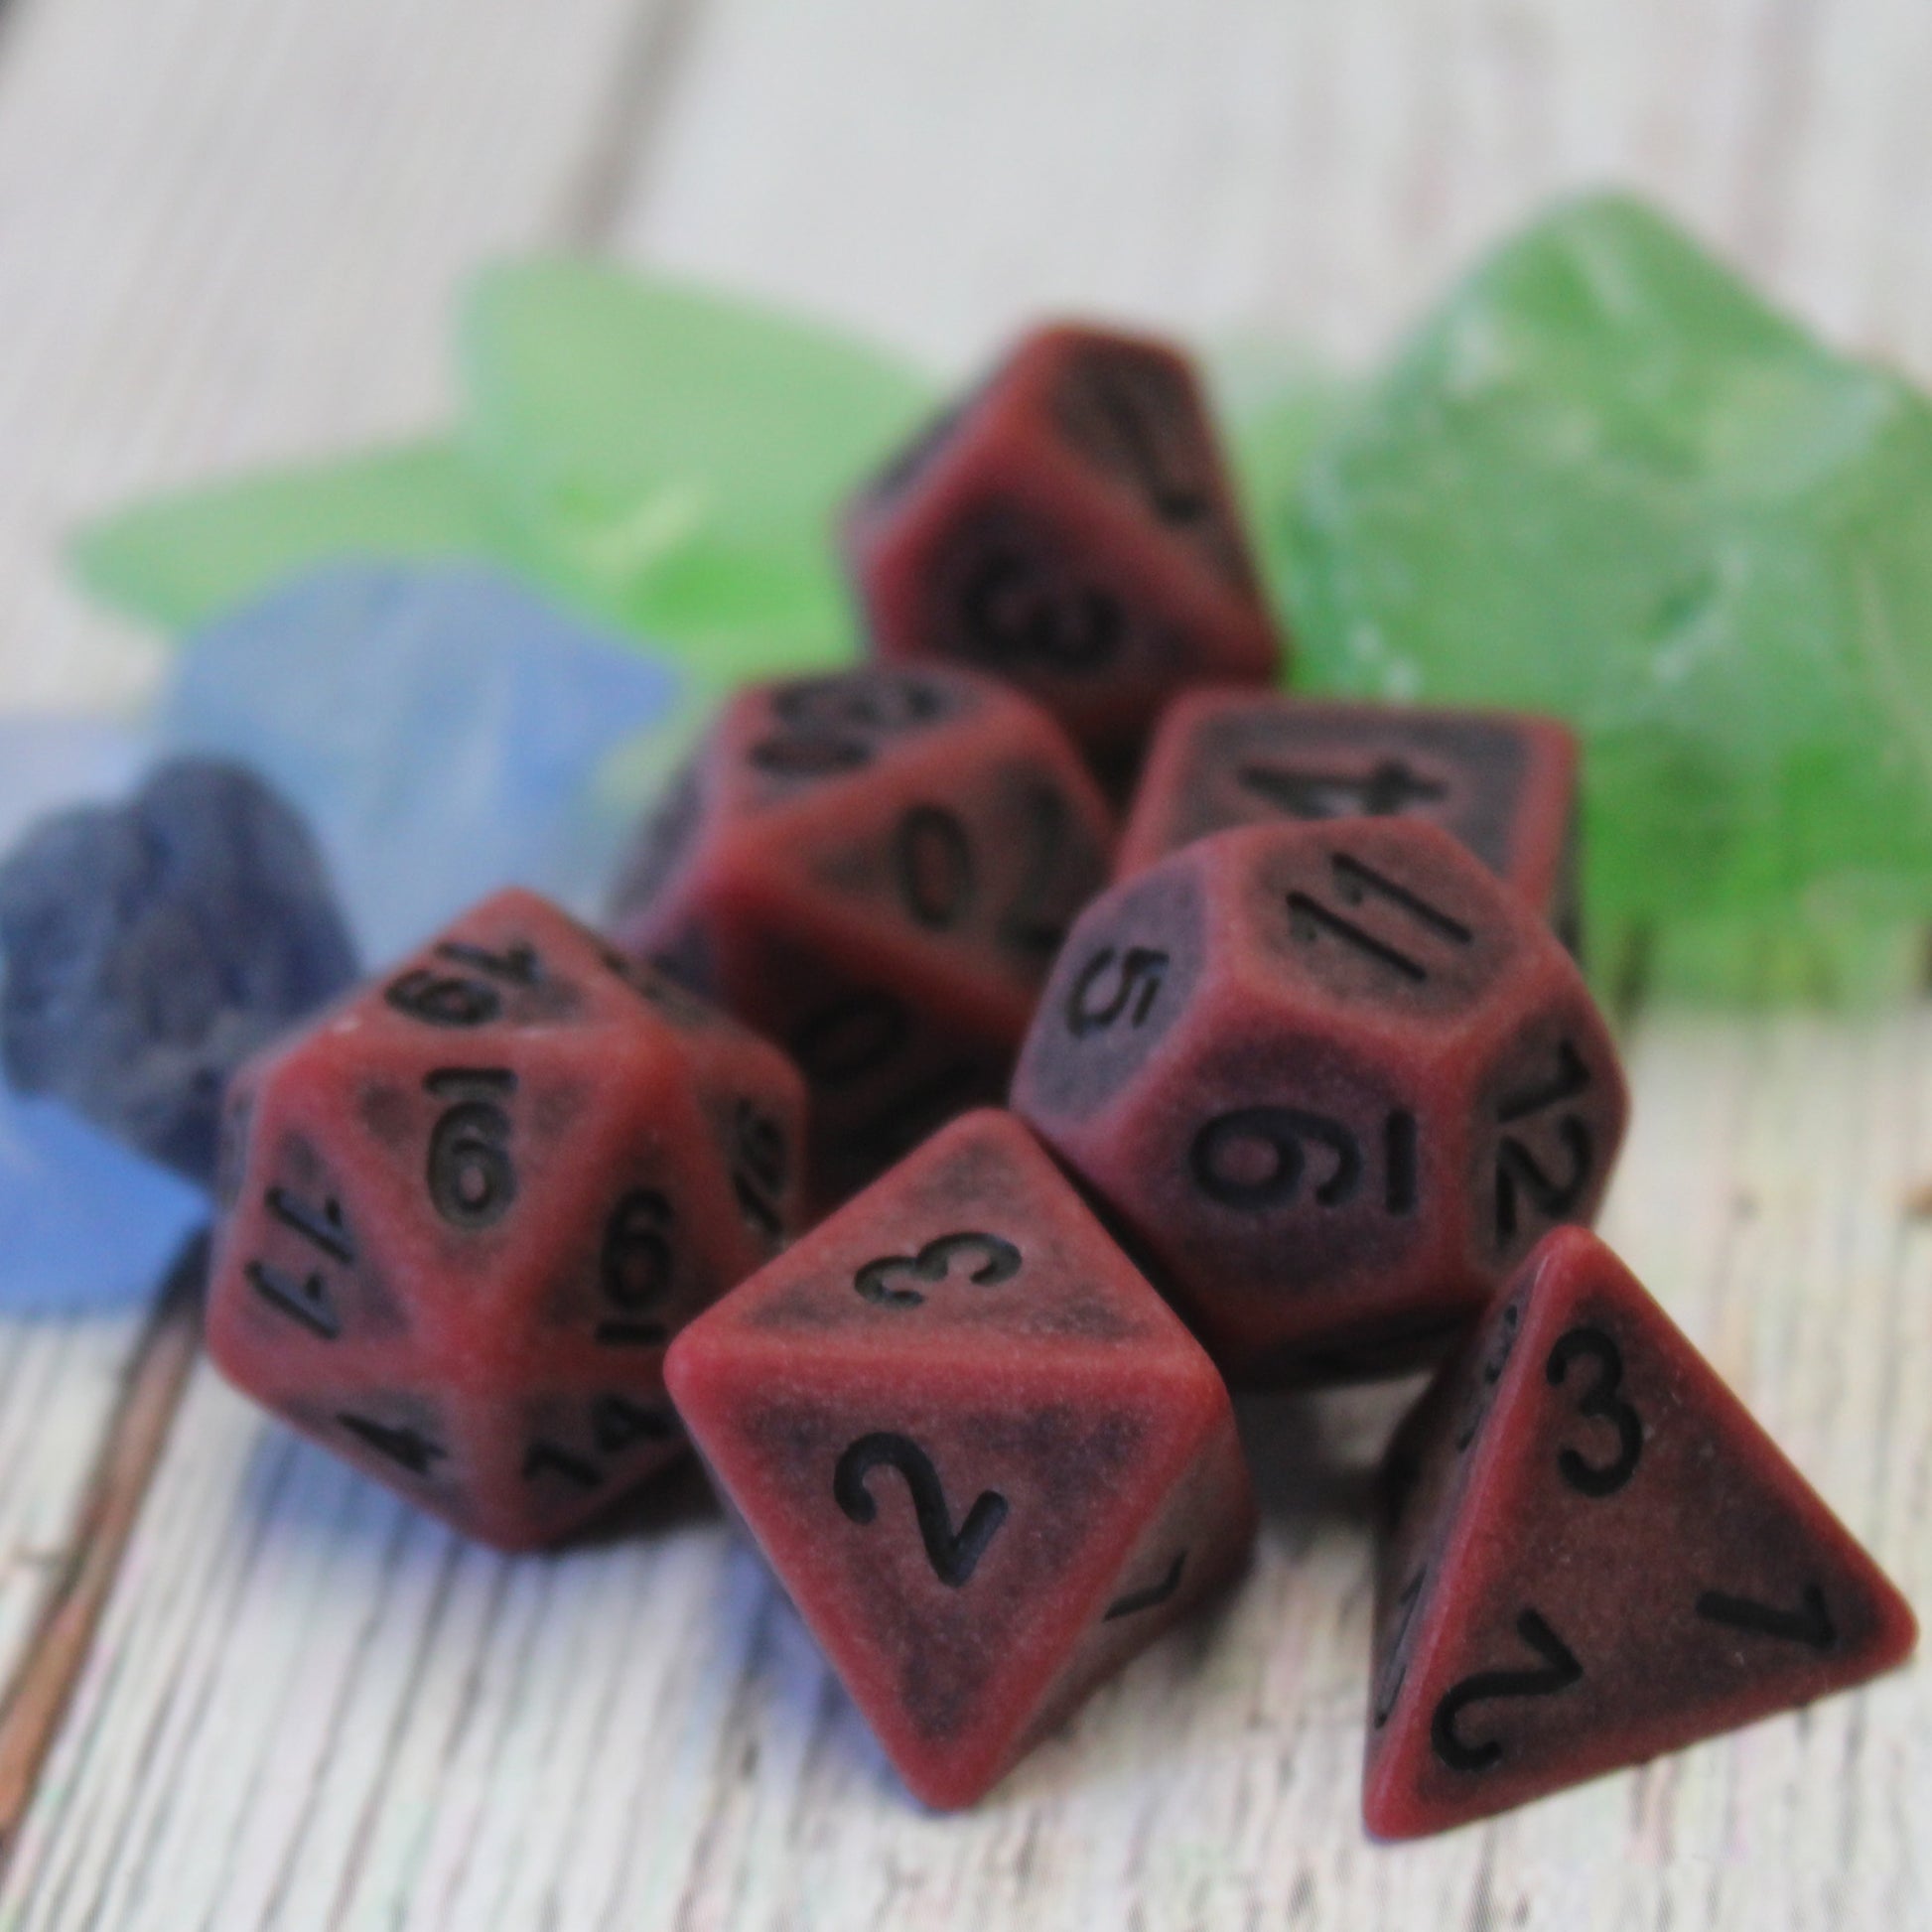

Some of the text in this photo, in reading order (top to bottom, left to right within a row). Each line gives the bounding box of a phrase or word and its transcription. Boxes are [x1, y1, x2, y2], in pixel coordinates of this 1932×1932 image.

[958, 556, 1127, 670] 3
[1236, 750, 1451, 826] 4
[1284, 849, 1474, 988] 11
[1064, 943, 1170, 1040] 5
[1493, 1037, 1590, 1239] 12
[854, 1229, 1024, 1311] 3
[336, 1413, 449, 1476] 4
[1547, 1326, 1643, 1498] 3
[832, 1431, 1010, 1588] 2
[1696, 1582, 1839, 1651] 1
[1431, 1607, 1585, 1771] 2
